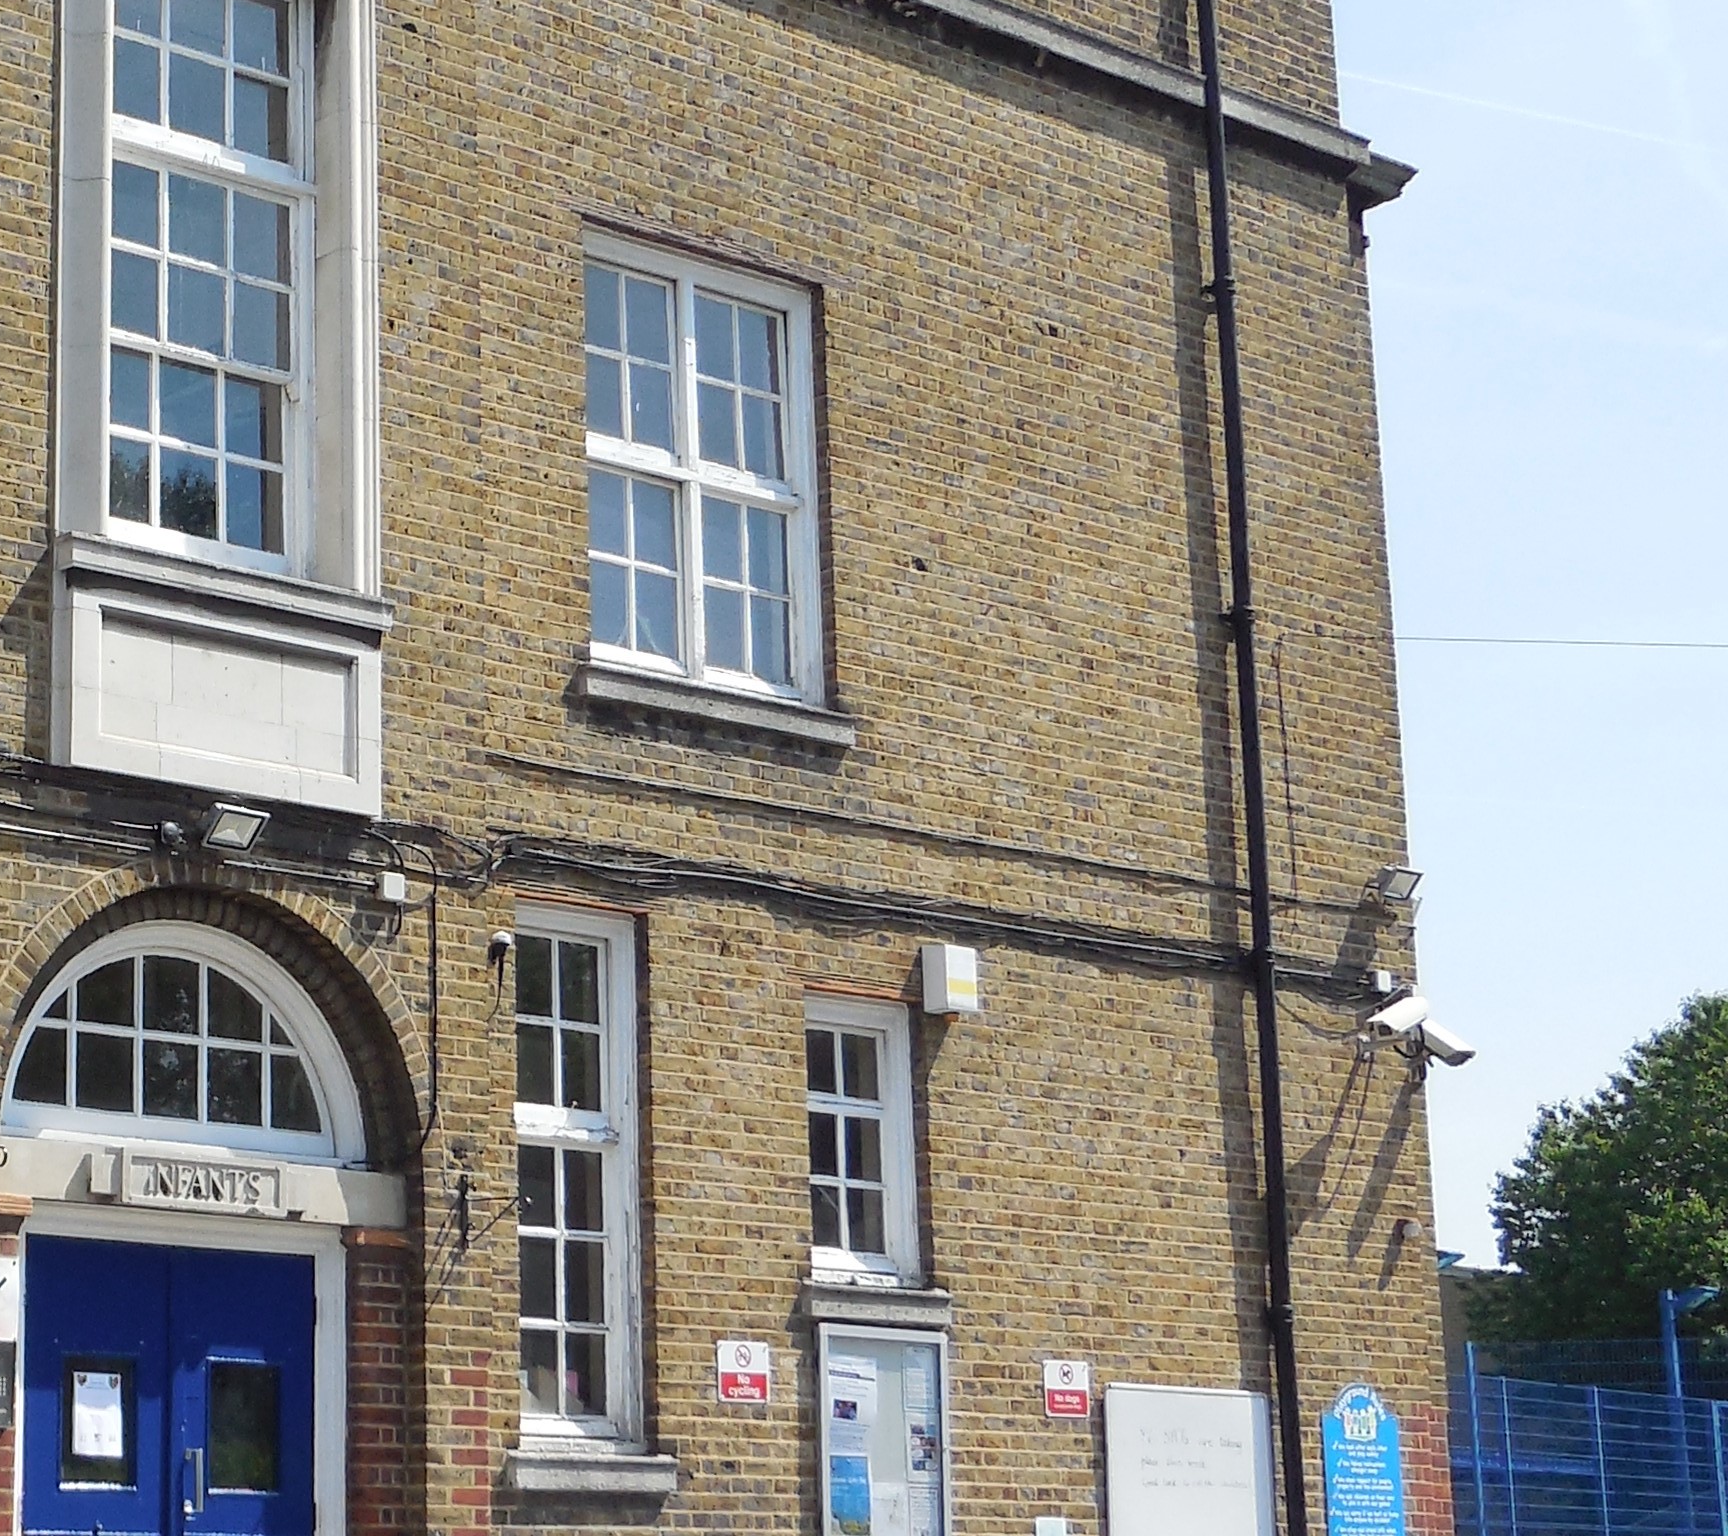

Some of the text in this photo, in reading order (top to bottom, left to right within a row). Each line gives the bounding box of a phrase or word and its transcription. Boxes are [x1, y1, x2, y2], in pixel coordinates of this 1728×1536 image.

[146, 1162, 261, 1202] INFANTS
[737, 1374, 751, 1384] No
[728, 1385, 760, 1398] cycling
[1054, 1394, 1080, 1404] No dogs
